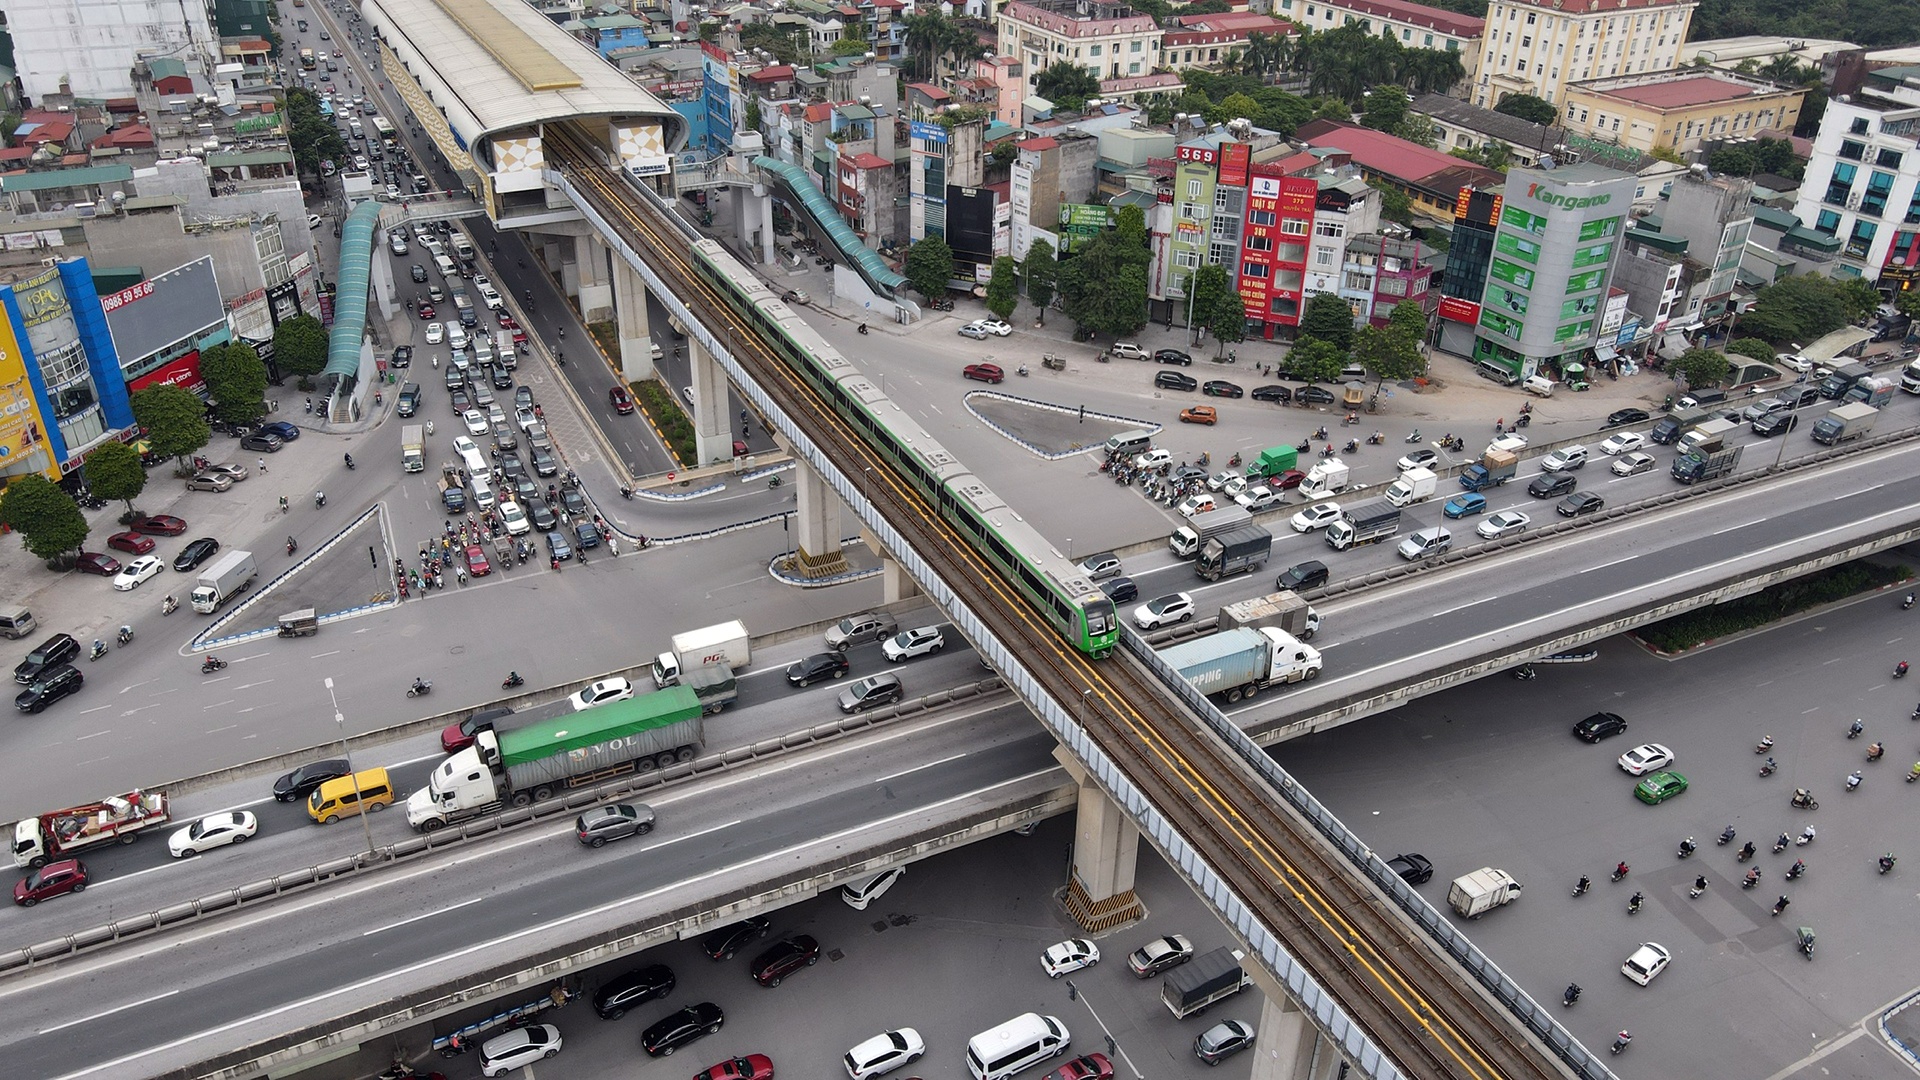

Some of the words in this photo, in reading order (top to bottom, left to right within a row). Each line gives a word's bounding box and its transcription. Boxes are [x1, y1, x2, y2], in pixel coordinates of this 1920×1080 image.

[1181, 148, 1213, 162] 369
[1252, 198, 1265, 210] LUẬT
[1254, 227, 1266, 237] 369
[176, 371, 192, 383] store
[120, 429, 132, 442] ANH
[69, 457, 82, 469] NHA
